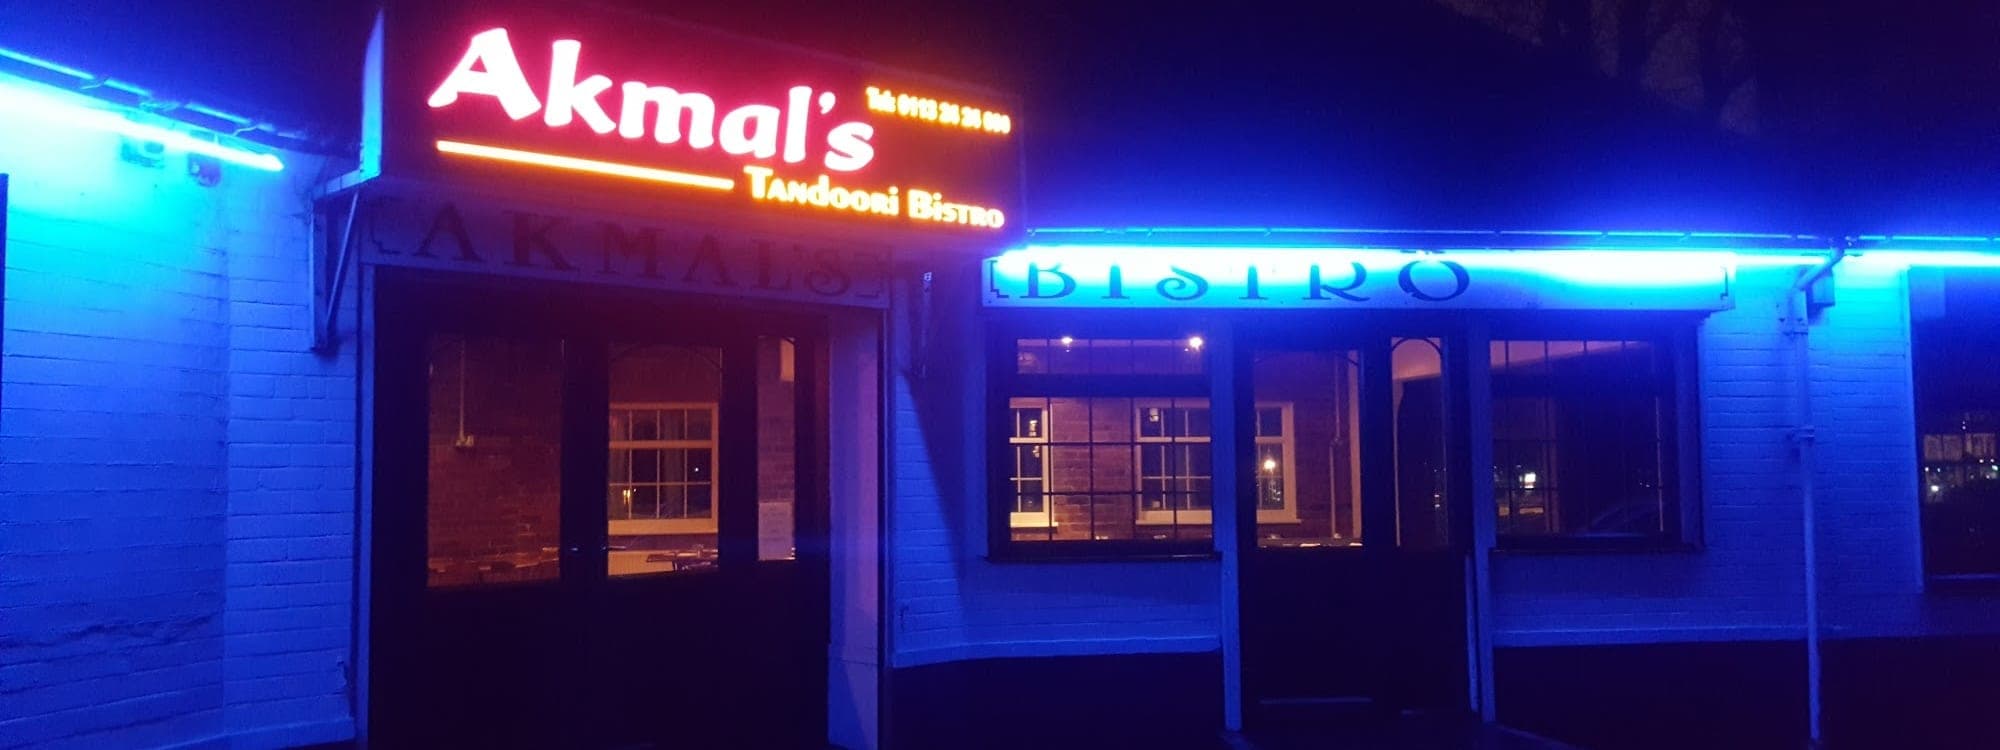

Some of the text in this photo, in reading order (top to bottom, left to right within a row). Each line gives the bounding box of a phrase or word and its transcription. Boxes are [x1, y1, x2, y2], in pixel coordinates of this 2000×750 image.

[427, 27, 875, 171] Akmal's
[412, 202, 851, 297] AKMAL'S
[1019, 258, 1471, 302] BISTRO
